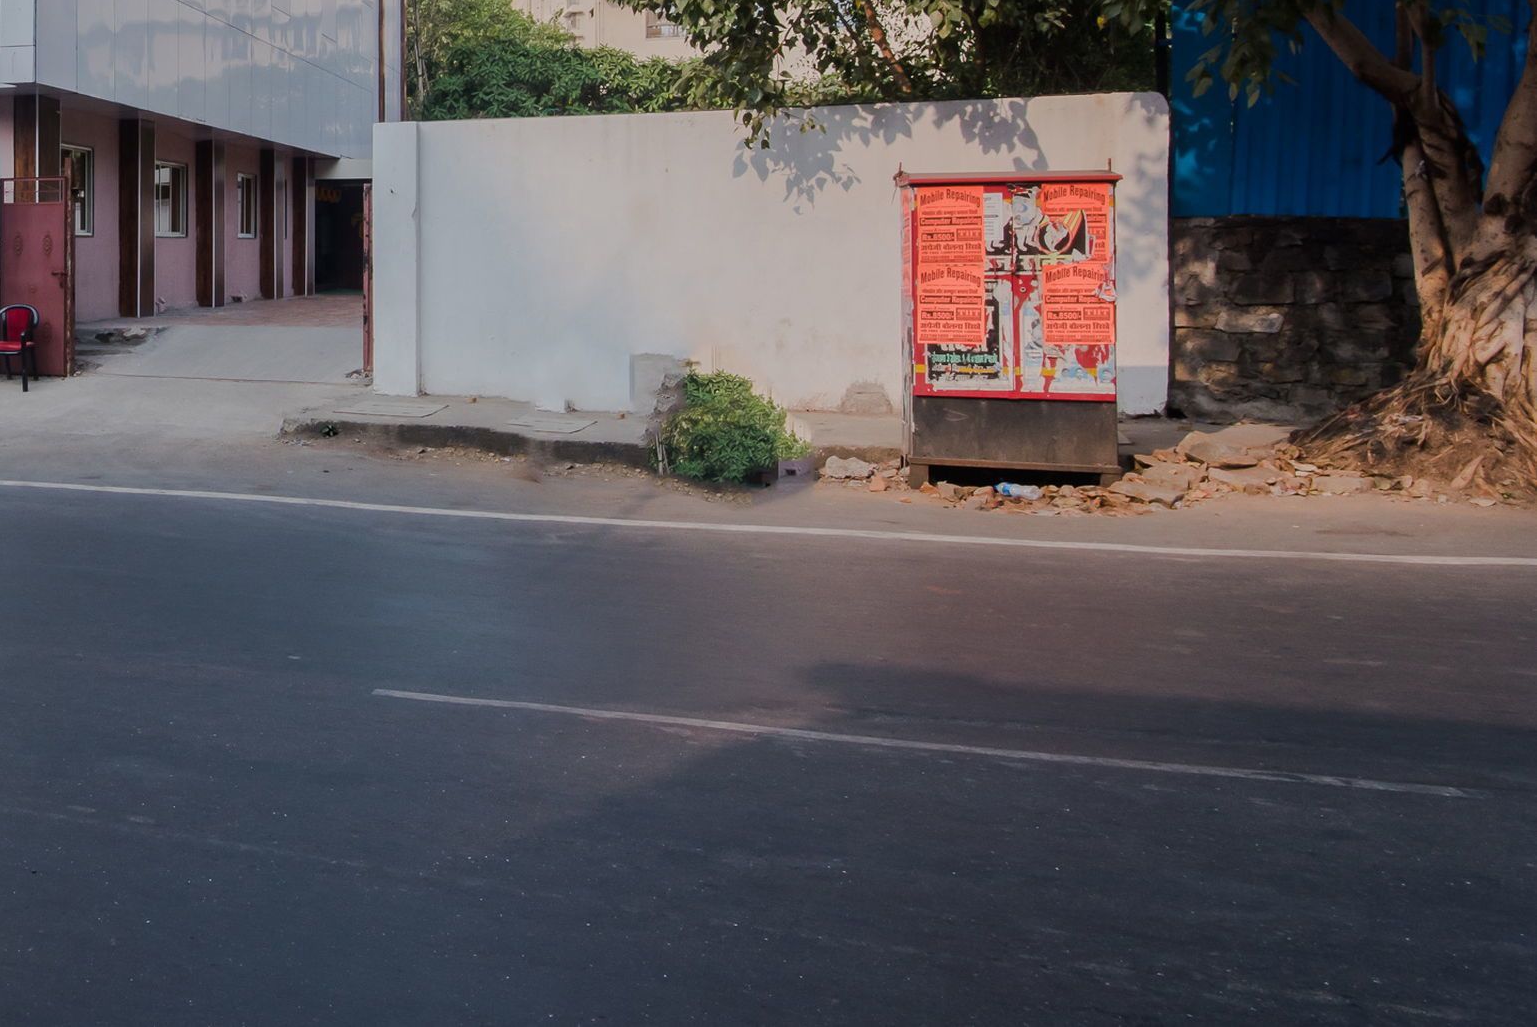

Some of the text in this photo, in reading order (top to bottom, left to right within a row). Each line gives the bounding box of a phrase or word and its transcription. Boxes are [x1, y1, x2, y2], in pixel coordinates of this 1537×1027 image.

[920, 188, 980, 208] Mobile Repairing
[1043, 185, 1105, 205] Mobile Repairing
[921, 267, 981, 288] Mobile Repairing
[1045, 266, 1105, 283] Mobile Repairin
[921, 296, 981, 305] Computer Repairing
[1046, 295, 1077, 304] Computer
